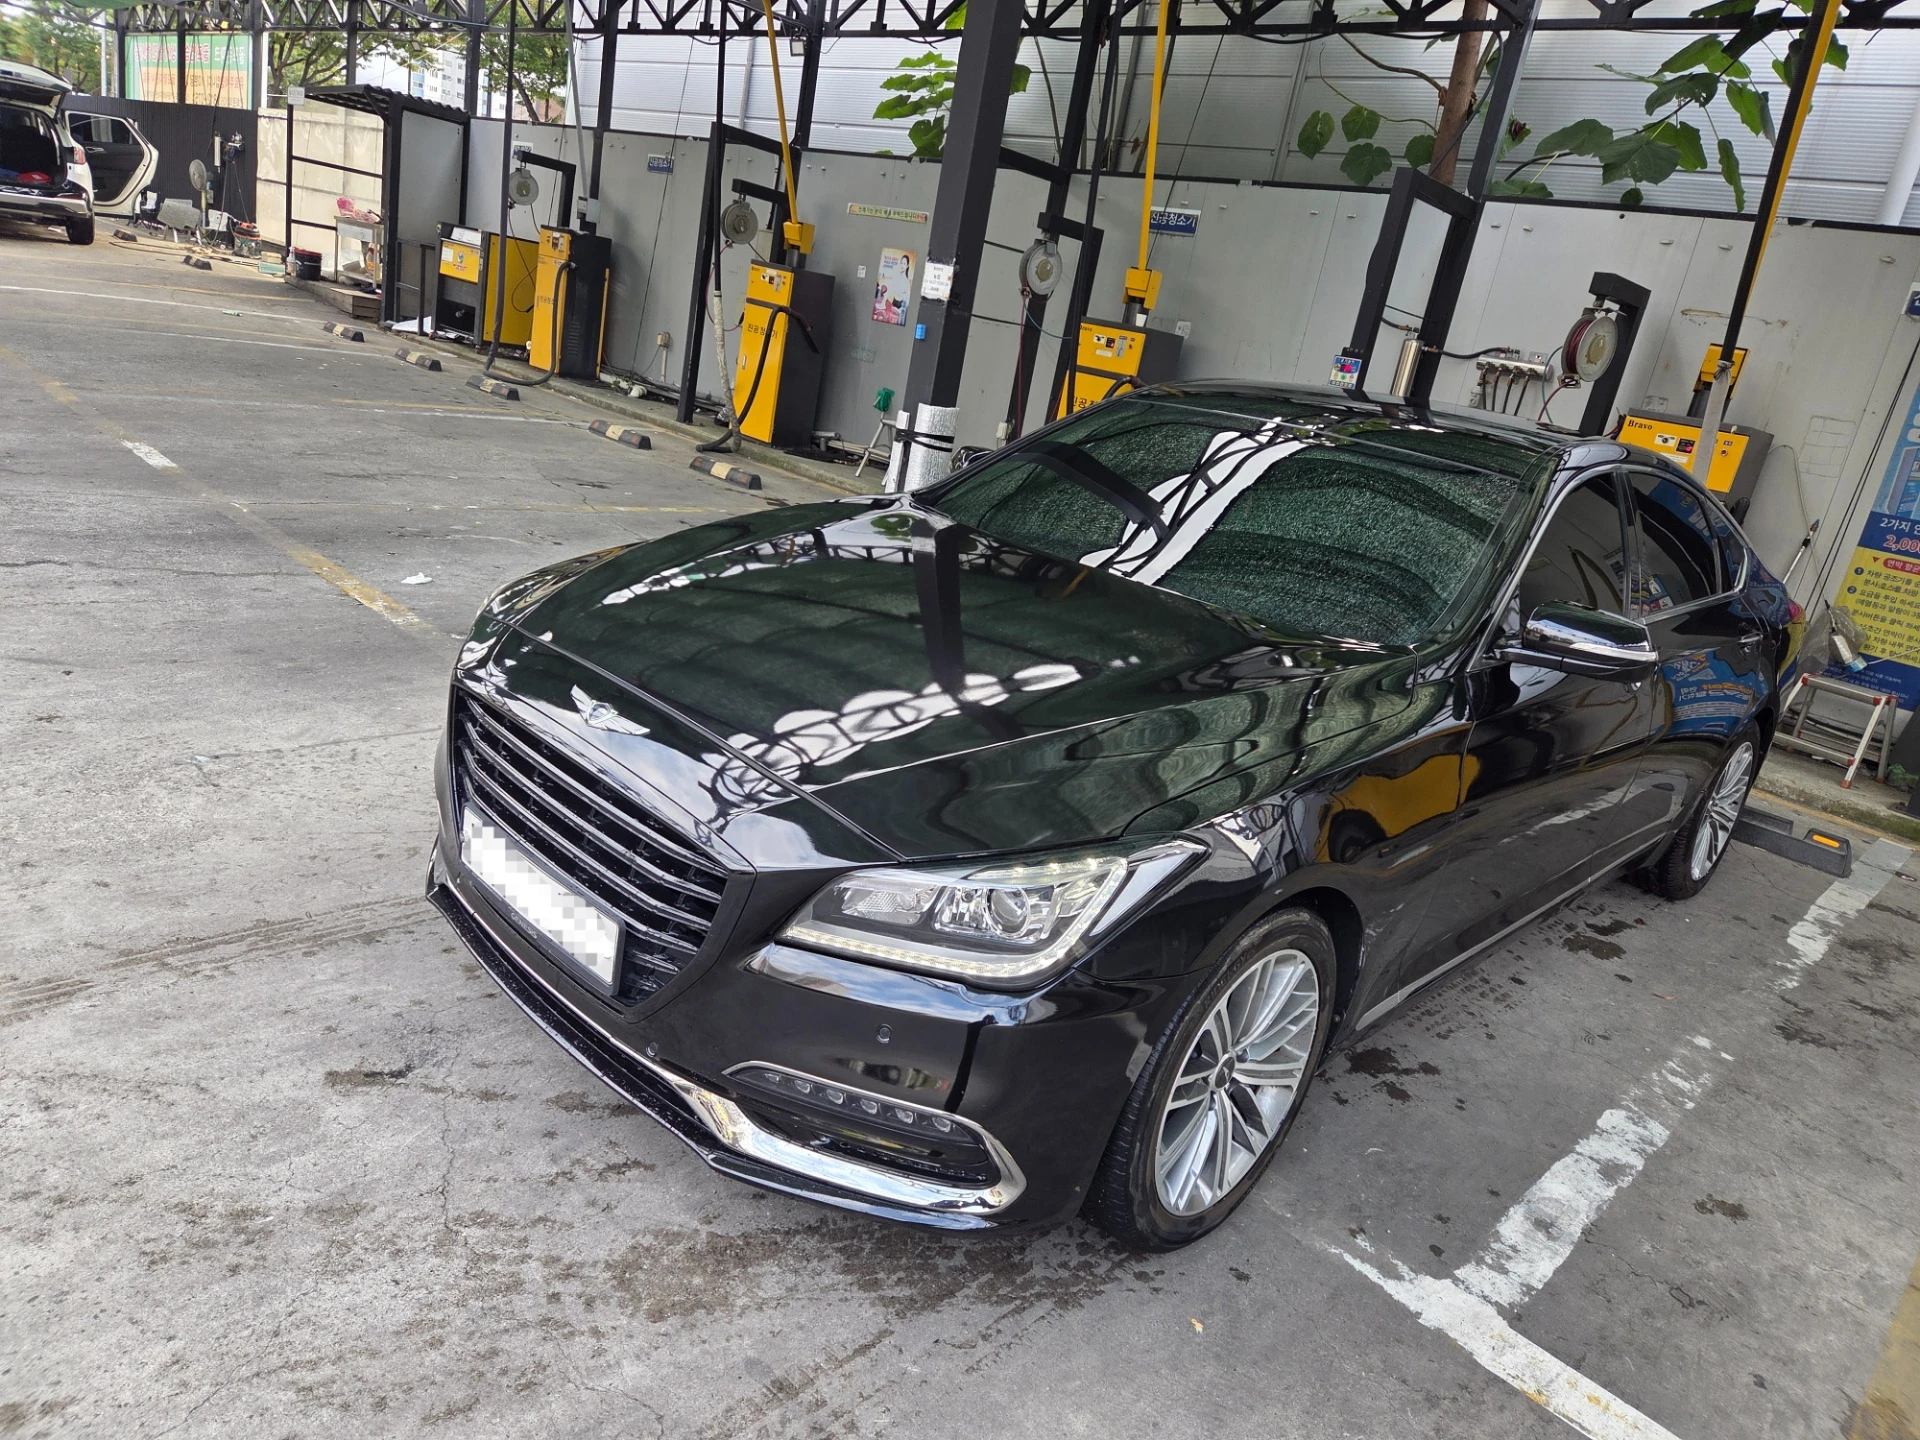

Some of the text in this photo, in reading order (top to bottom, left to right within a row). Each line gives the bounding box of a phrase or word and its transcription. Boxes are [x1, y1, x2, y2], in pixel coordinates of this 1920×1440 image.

[1150, 211, 1196, 227] 진공청소기
[747, 323, 778, 339] 진공청기
[1627, 419, 1653, 430] Bravo
[1880, 517, 1911, 532] 2가지
[1883, 534, 1920, 554] 2,00
[510, 912, 538, 939] GENESIS
